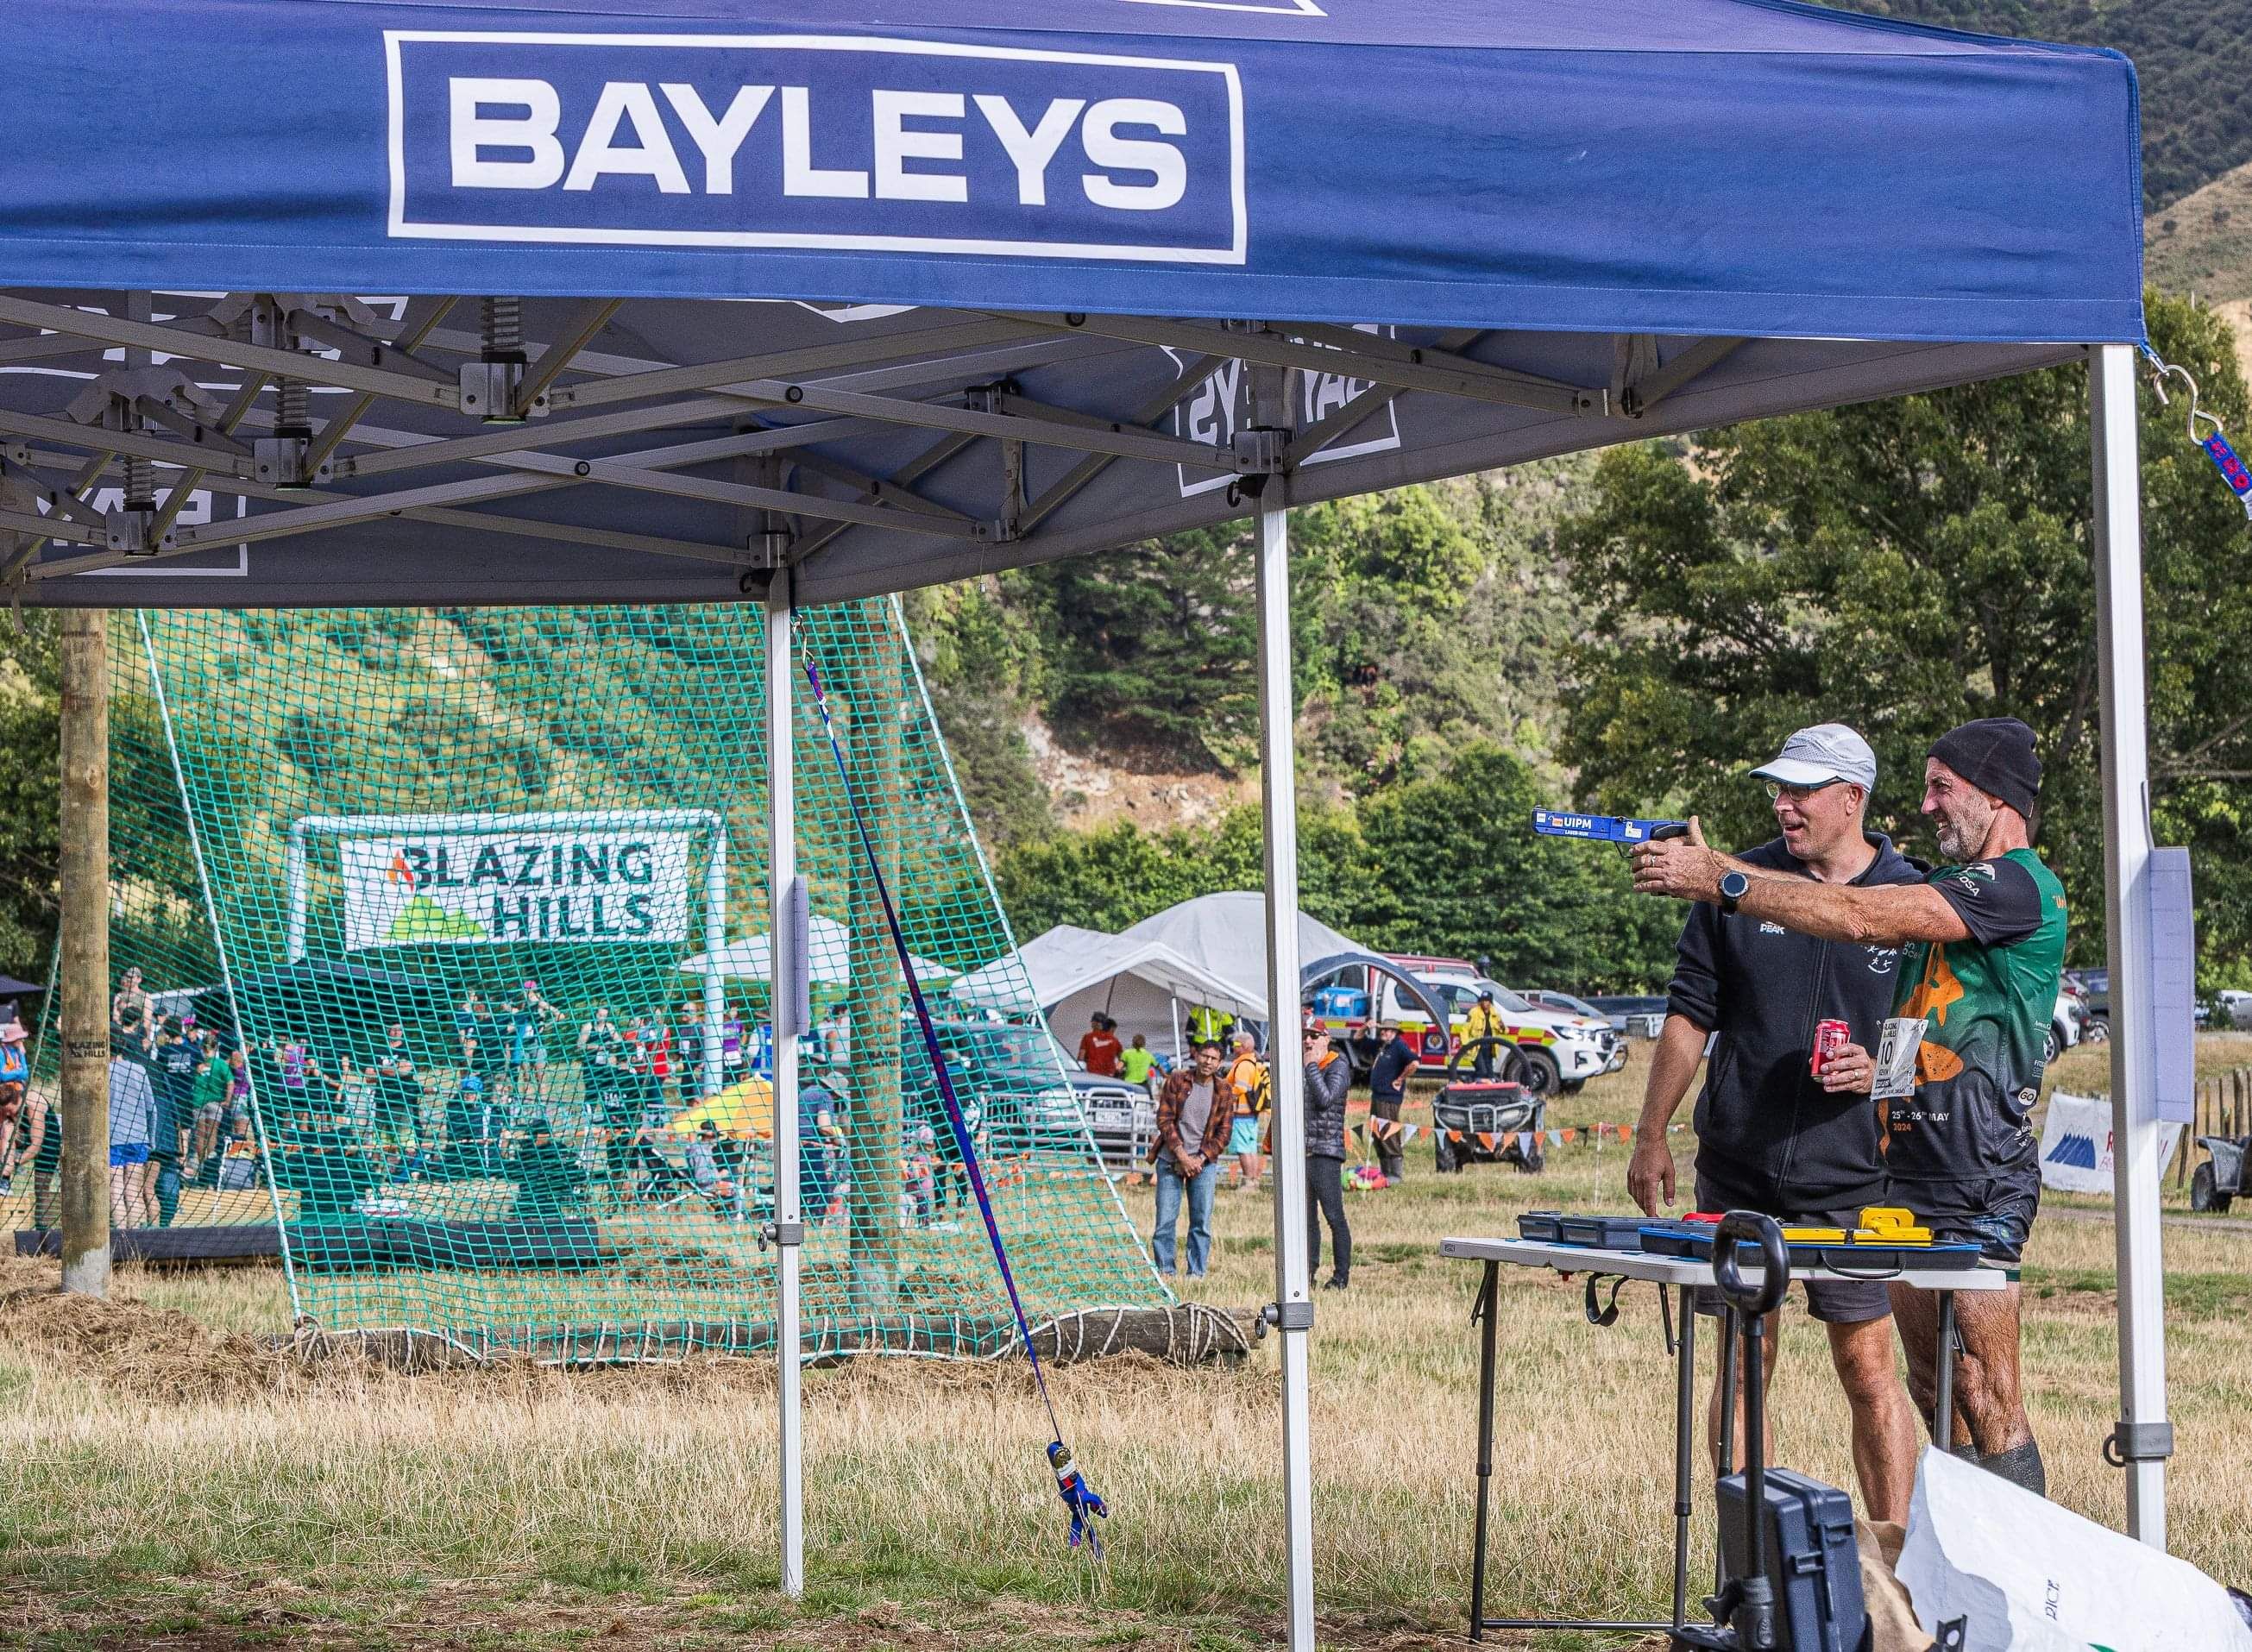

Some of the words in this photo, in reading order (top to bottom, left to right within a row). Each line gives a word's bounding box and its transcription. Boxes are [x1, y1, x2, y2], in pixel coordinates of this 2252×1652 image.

[448, 76, 1188, 212] BAYLEYS
[1563, 817, 1592, 829] UIPM
[400, 843, 653, 889] BLAZING
[492, 894, 655, 939] HILLS
[1760, 923, 1785, 934] PEAK
[1881, 1040, 1893, 1065] 10
[2020, 1091, 2035, 1101] GO
[1928, 1112, 1949, 1121] MAY
[1893, 1122, 1911, 1132] 2024
